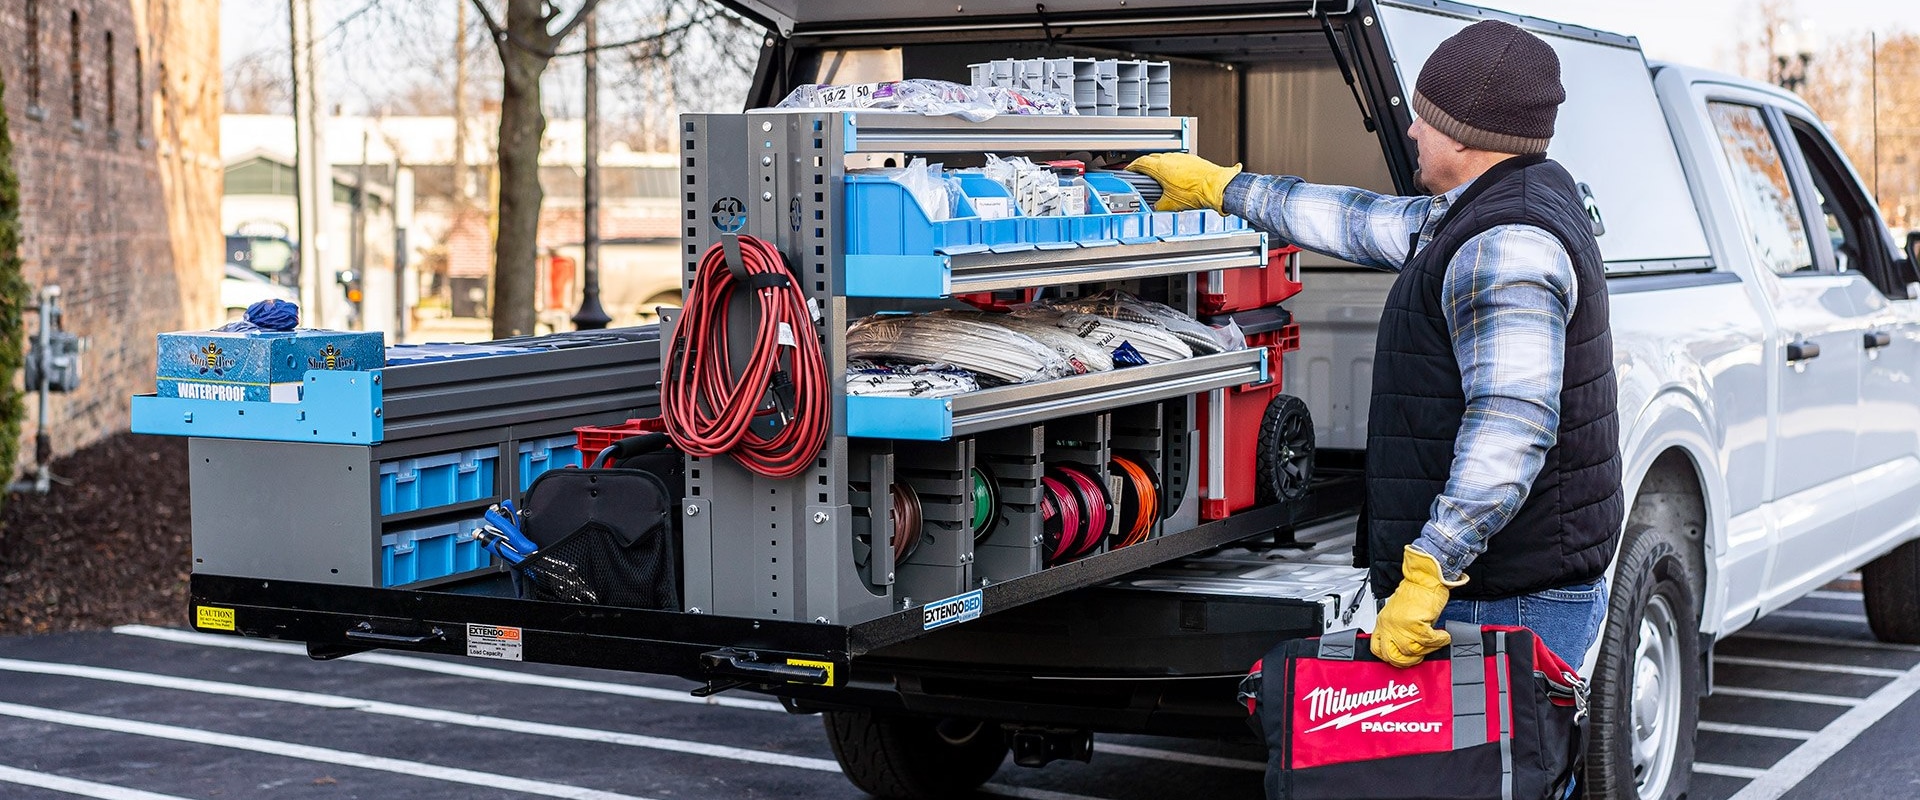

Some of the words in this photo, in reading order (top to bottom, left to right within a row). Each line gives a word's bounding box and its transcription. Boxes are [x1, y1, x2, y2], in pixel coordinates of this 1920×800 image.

[822, 89, 846, 105] 14/2
[857, 85, 869, 98] 50
[178, 382, 246, 401] WATERPROOF
[200, 608, 233, 618] CAUTION!
[924, 596, 980, 624] EXTENDOBED
[470, 627, 518, 638] EXTENDOBED
[482, 649, 503, 657] Capacity
[1303, 680, 1420, 722] Milwaukee
[1361, 721, 1443, 733] PACKOUT
